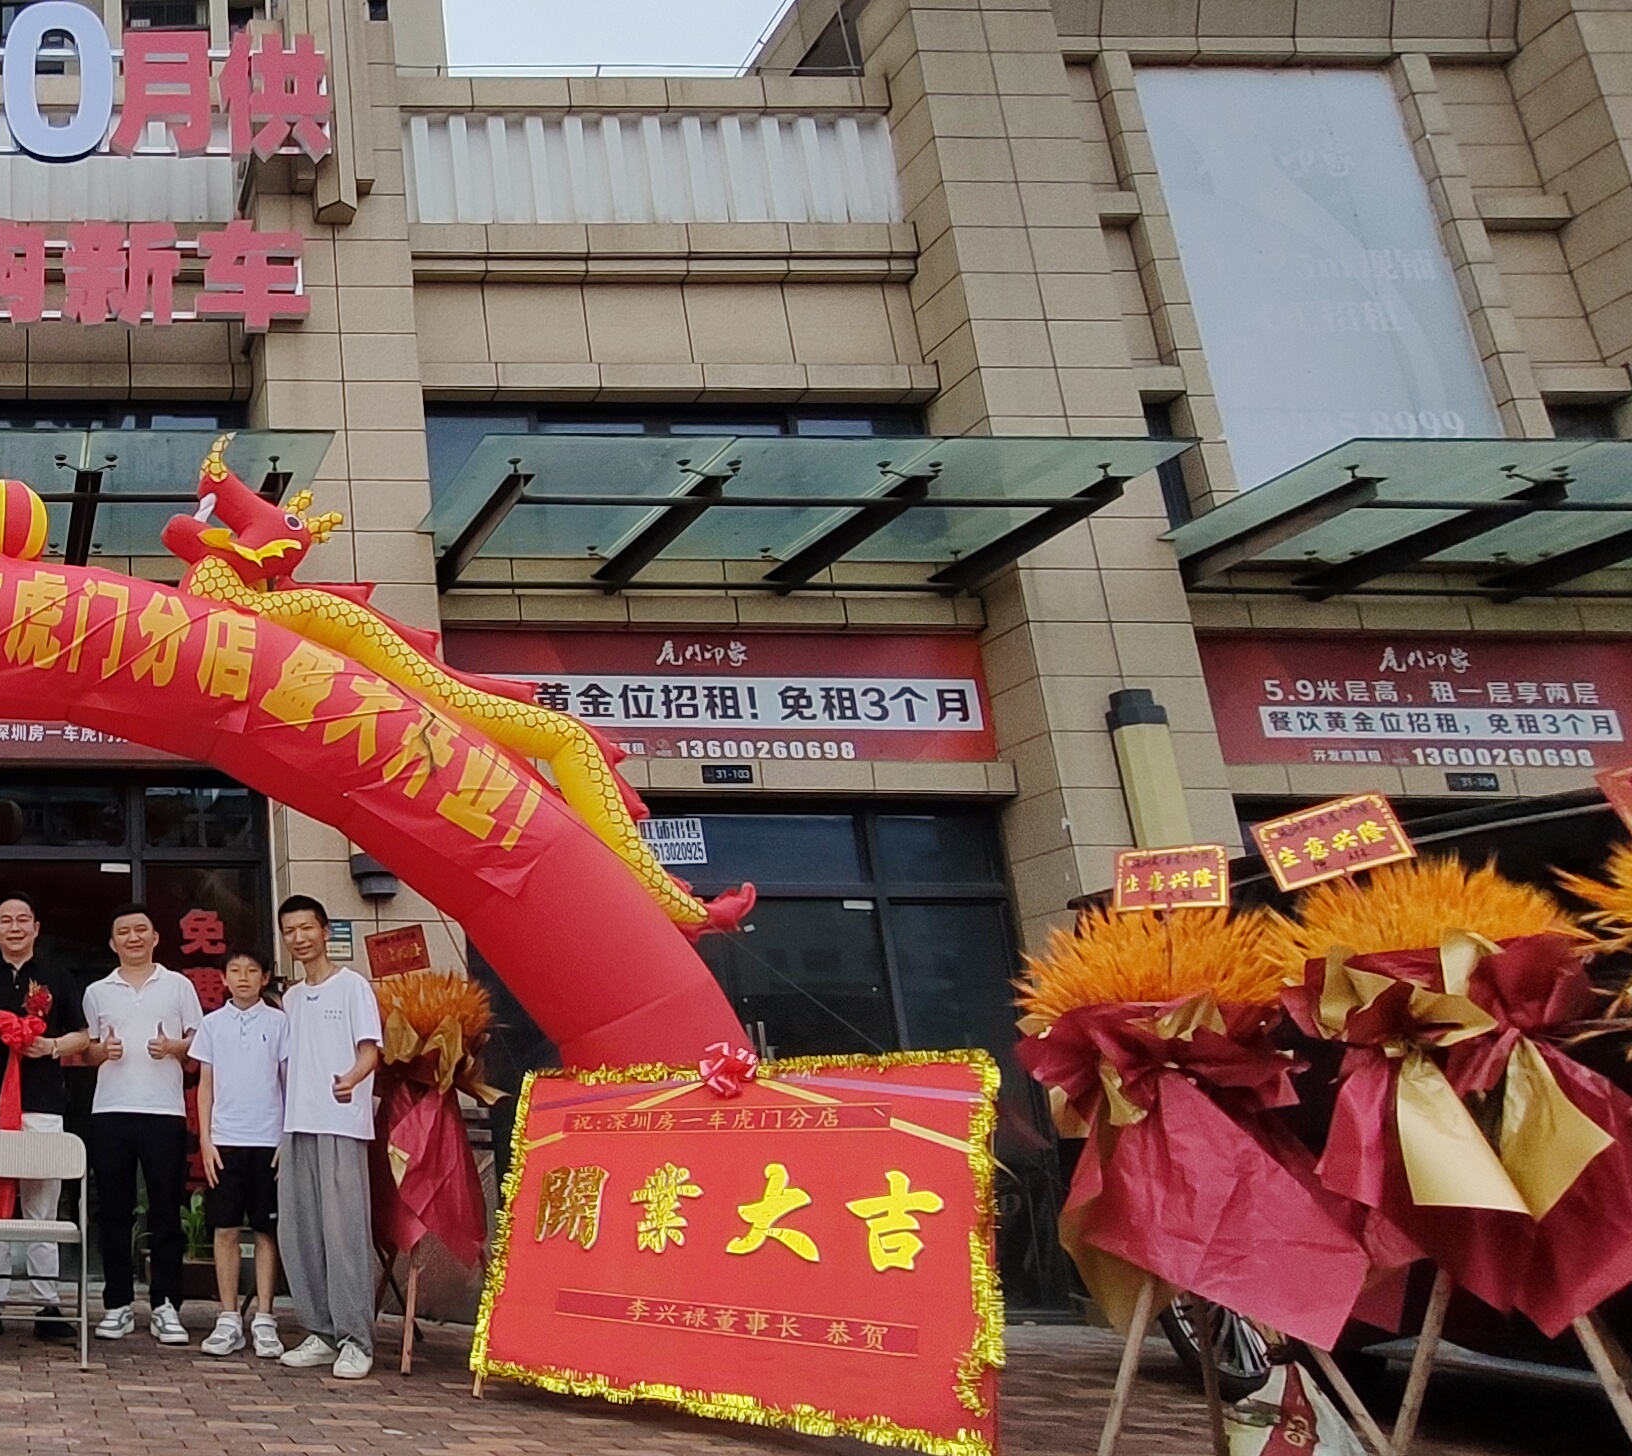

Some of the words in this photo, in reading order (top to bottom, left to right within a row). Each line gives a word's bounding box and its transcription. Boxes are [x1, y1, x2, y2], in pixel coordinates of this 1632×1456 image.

[676, 739, 856, 760] 13600260698
[1412, 747, 1594, 767] 13600260698
[1278, 820, 1389, 868] 生意兴隆
[1125, 867, 1218, 893] 生意兴隆
[825, 1321, 890, 1351] 恭贺
